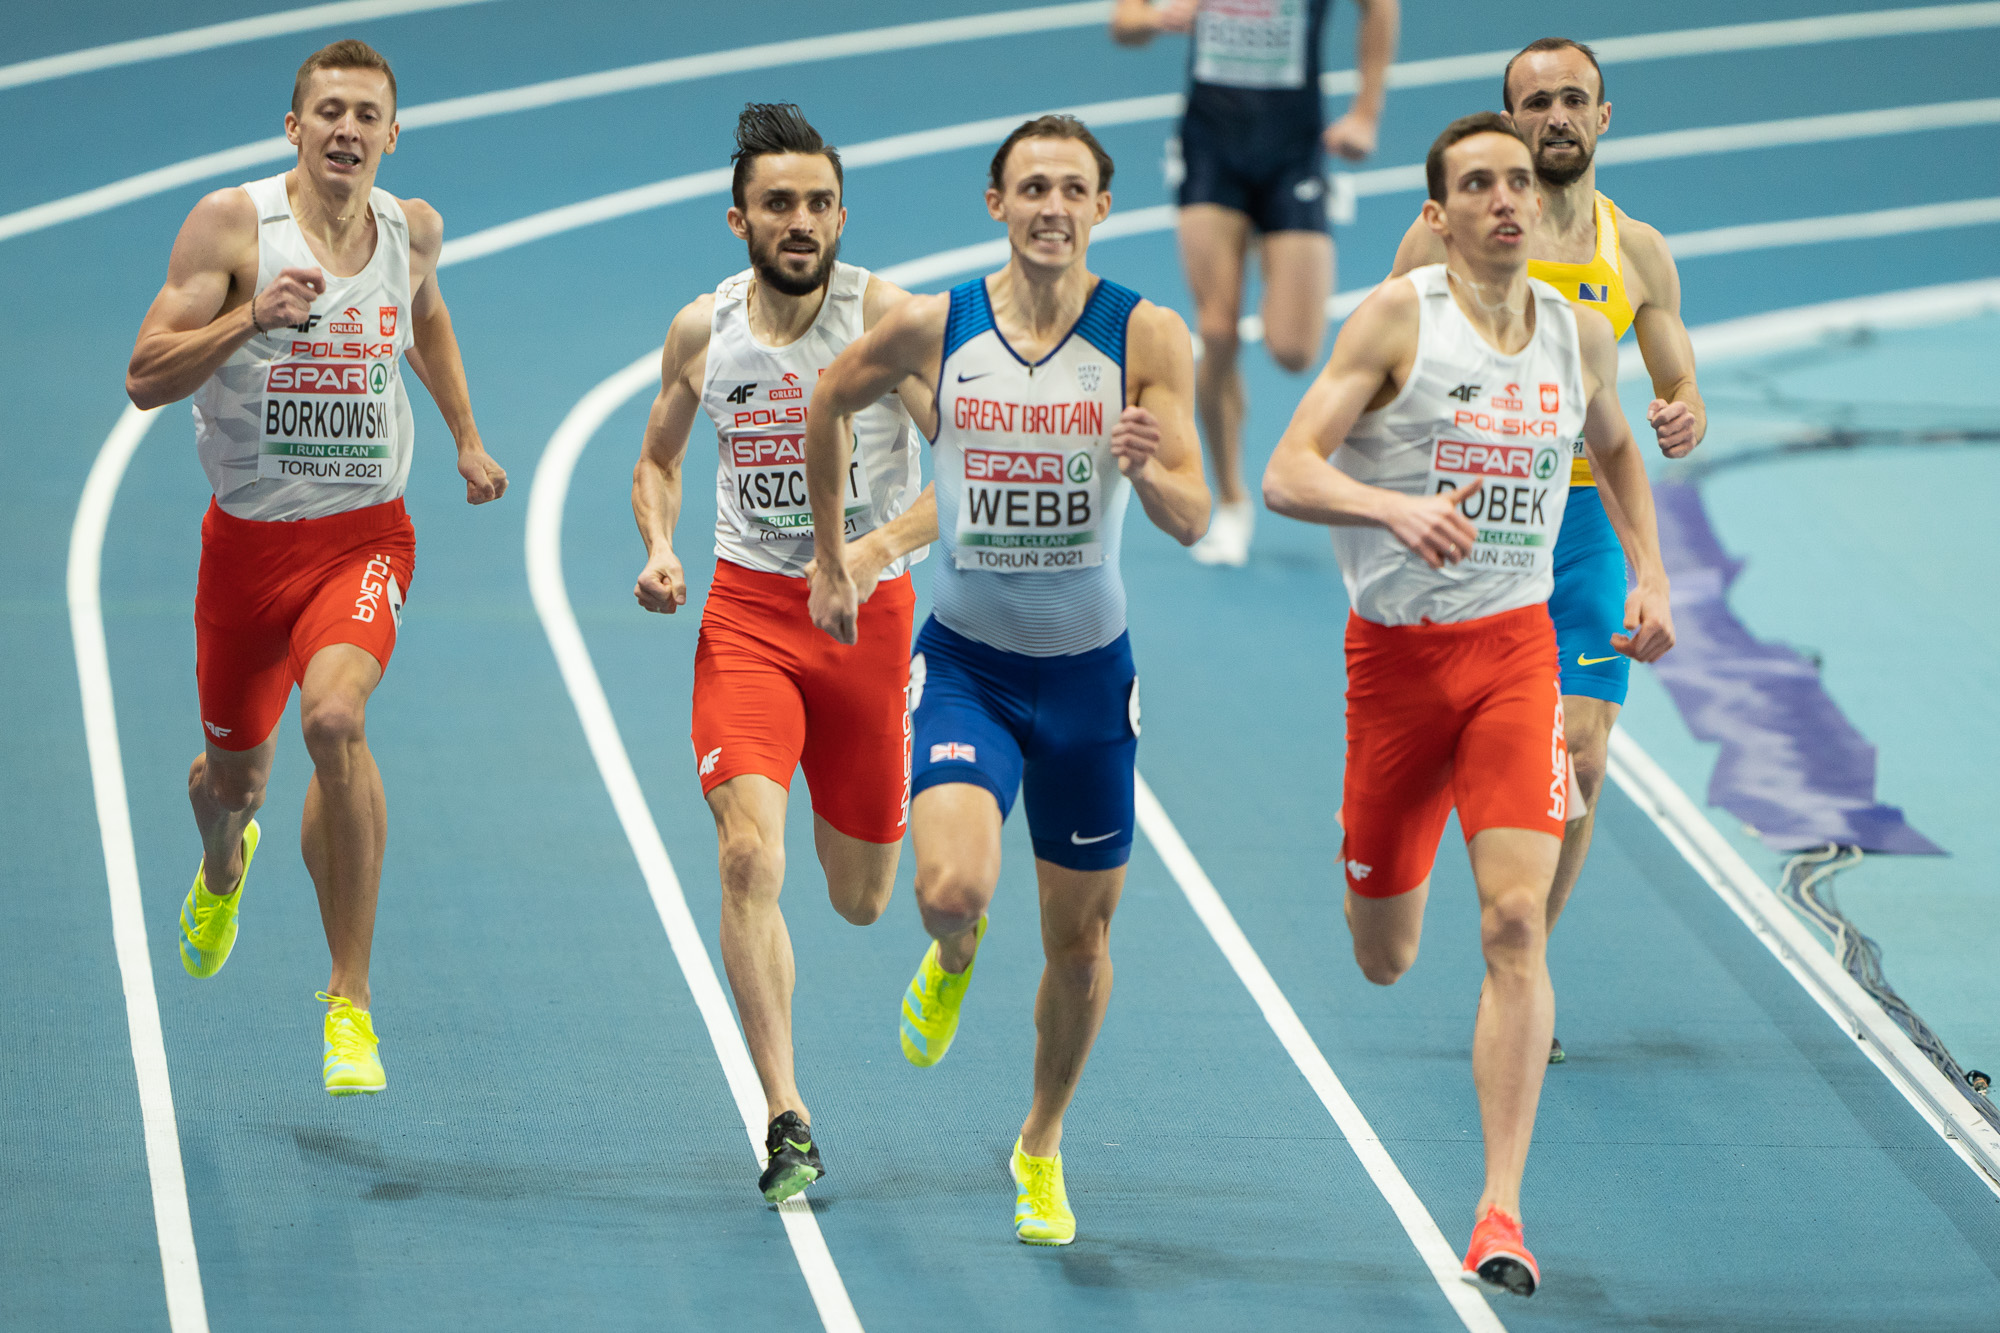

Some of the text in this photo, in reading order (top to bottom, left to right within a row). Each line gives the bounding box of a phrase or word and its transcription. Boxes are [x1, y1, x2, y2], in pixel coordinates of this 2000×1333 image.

[330, 323, 361, 334] ORLEN
[291, 341, 393, 359] POLSKA
[270, 366, 366, 390] SPAR
[726, 383, 758, 404] 4F
[771, 388, 801, 400] ORLEN
[1448, 385, 1482, 402] 4F
[266, 399, 389, 439] BORKOWSKI
[734, 407, 807, 428] POLS
[955, 397, 1103, 436] GREAT BRITAIN
[1454, 410, 1557, 438] POLSKA
[289, 444, 293, 455] I
[297, 445, 325, 456] RUN
[1438, 443, 1531, 475] SPAR
[278, 460, 382, 478] TORUŃ 2021
[966, 453, 1062, 481] SPAR
[738, 461, 858, 510] KSZCT
[969, 487, 1091, 528] WEBB
[991, 535, 1021, 546] RUN
[1044, 551, 1083, 567] 2021
[1502, 551, 1535, 567] 2021
[699, 747, 722, 777] 4F
